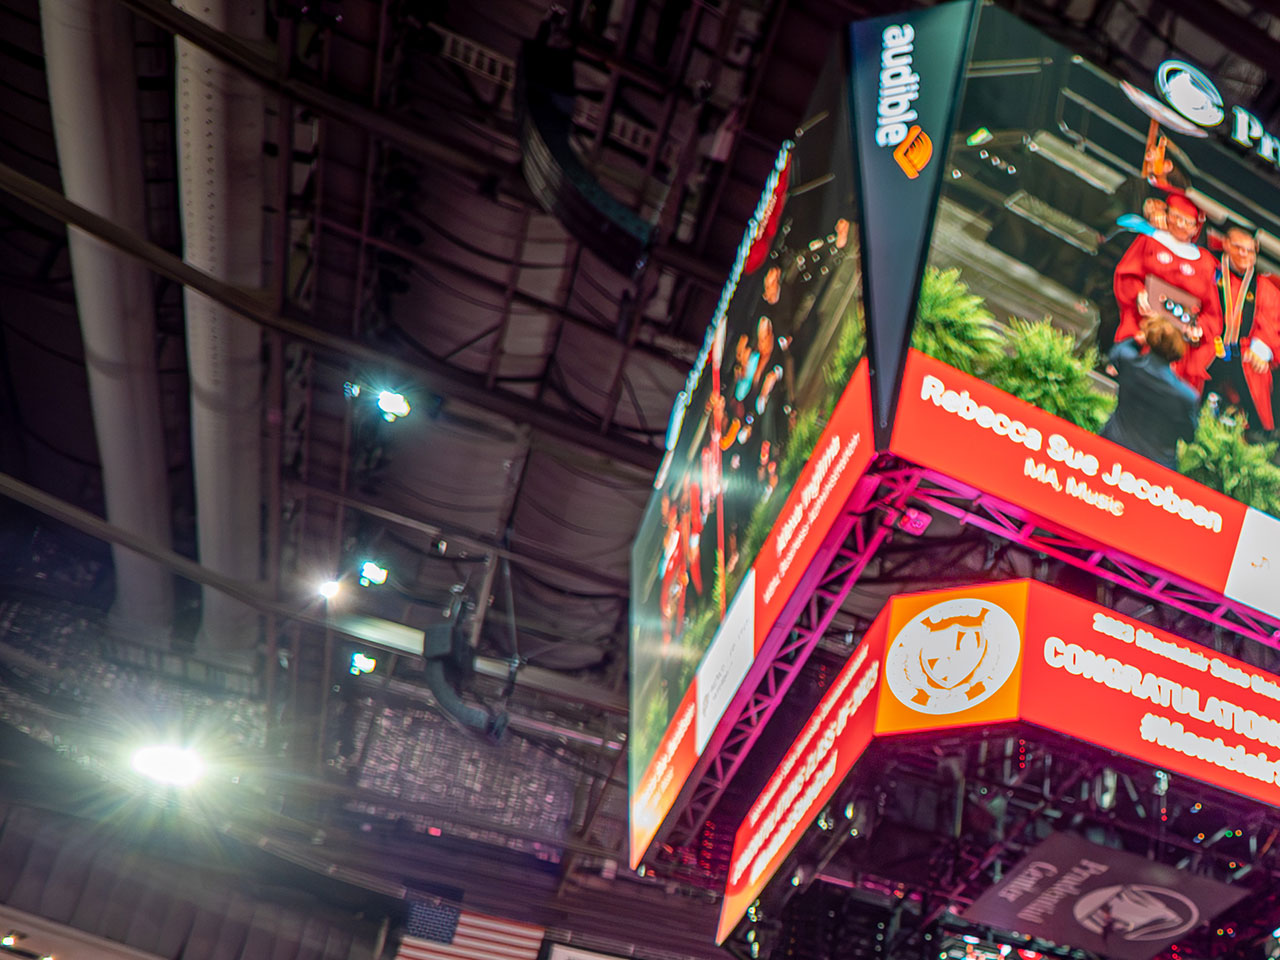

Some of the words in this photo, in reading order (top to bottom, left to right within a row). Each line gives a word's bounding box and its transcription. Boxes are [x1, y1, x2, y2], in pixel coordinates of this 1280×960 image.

[875, 23, 920, 147] audible
[920, 374, 1042, 452] Rebecca
[1046, 433, 1099, 476] Sue
[1065, 475, 1125, 516] Music
